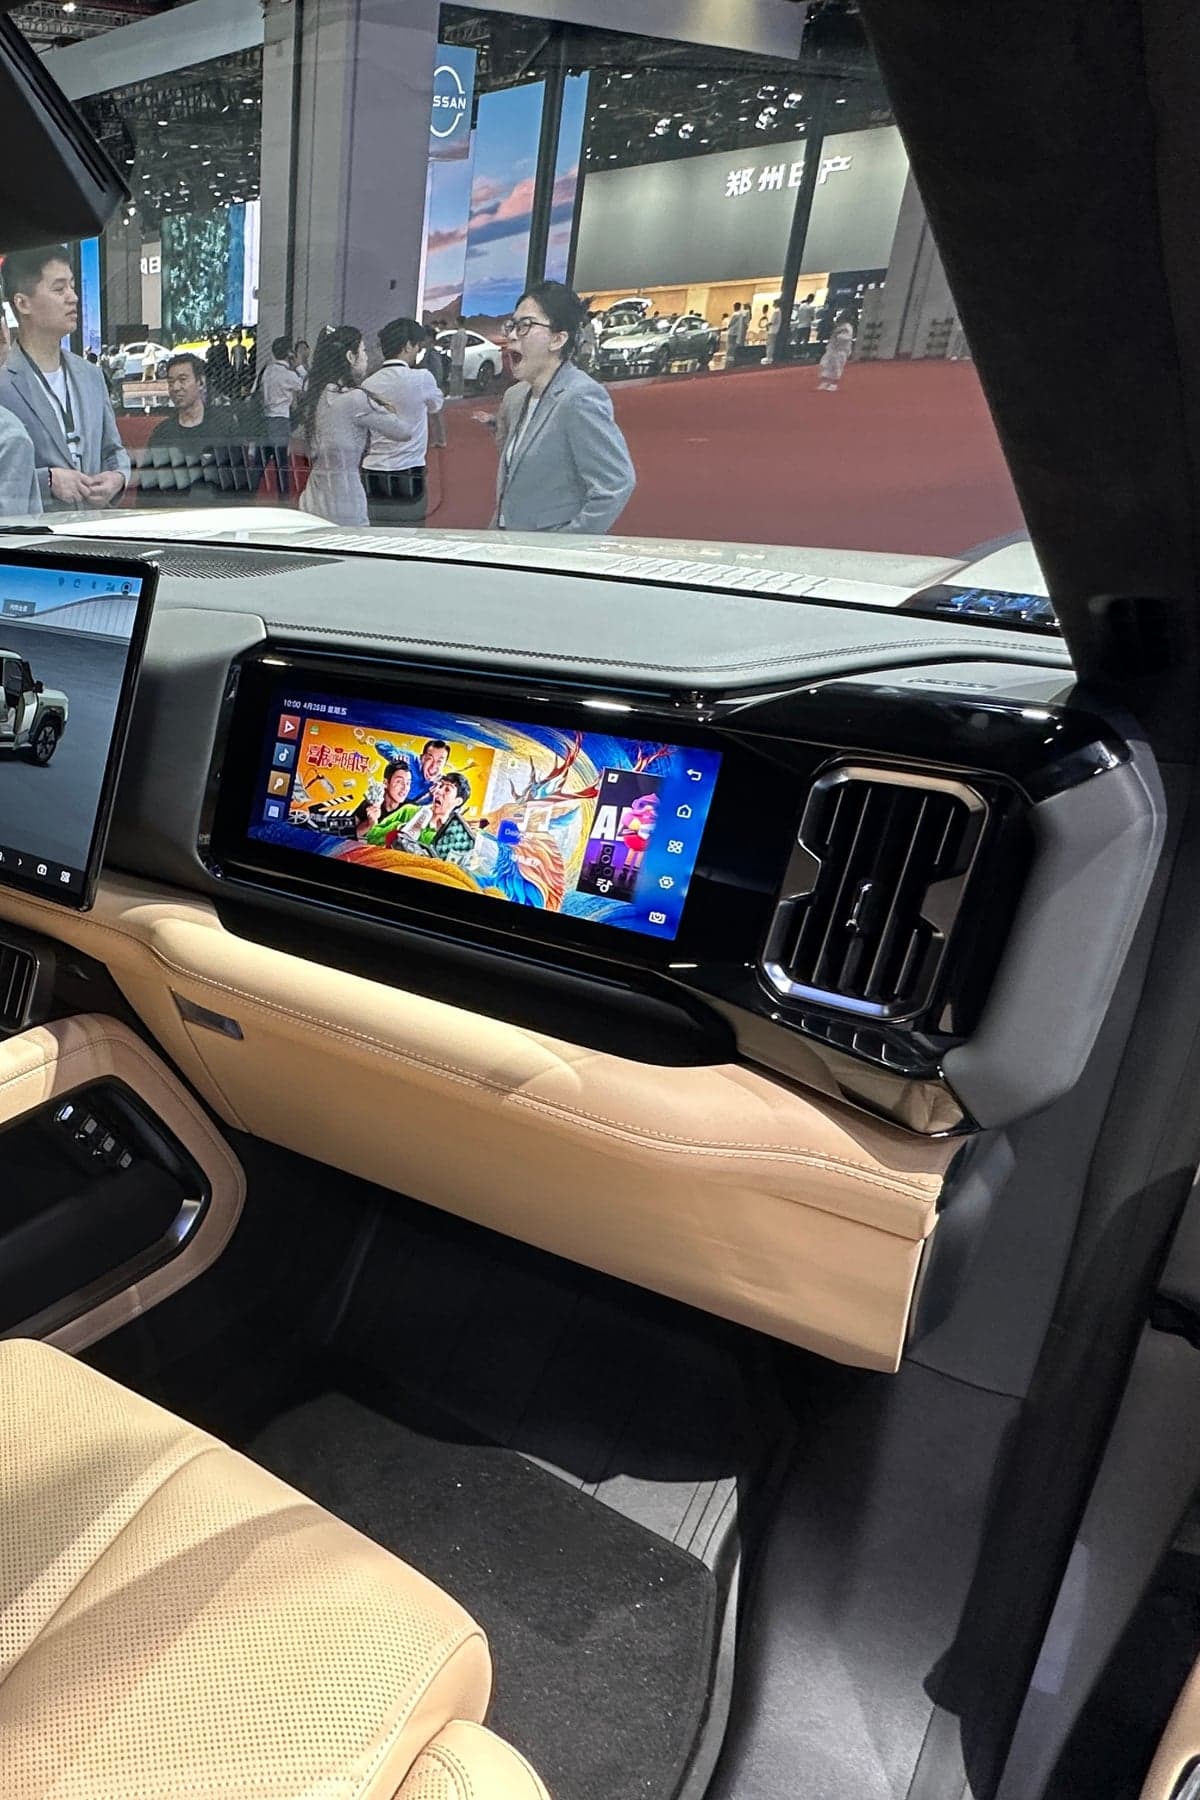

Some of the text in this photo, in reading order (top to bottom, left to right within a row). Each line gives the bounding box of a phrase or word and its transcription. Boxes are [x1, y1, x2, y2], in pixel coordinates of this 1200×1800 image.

[432, 96, 466, 109] SSAN
[725, 155, 852, 197] 郑州日产
